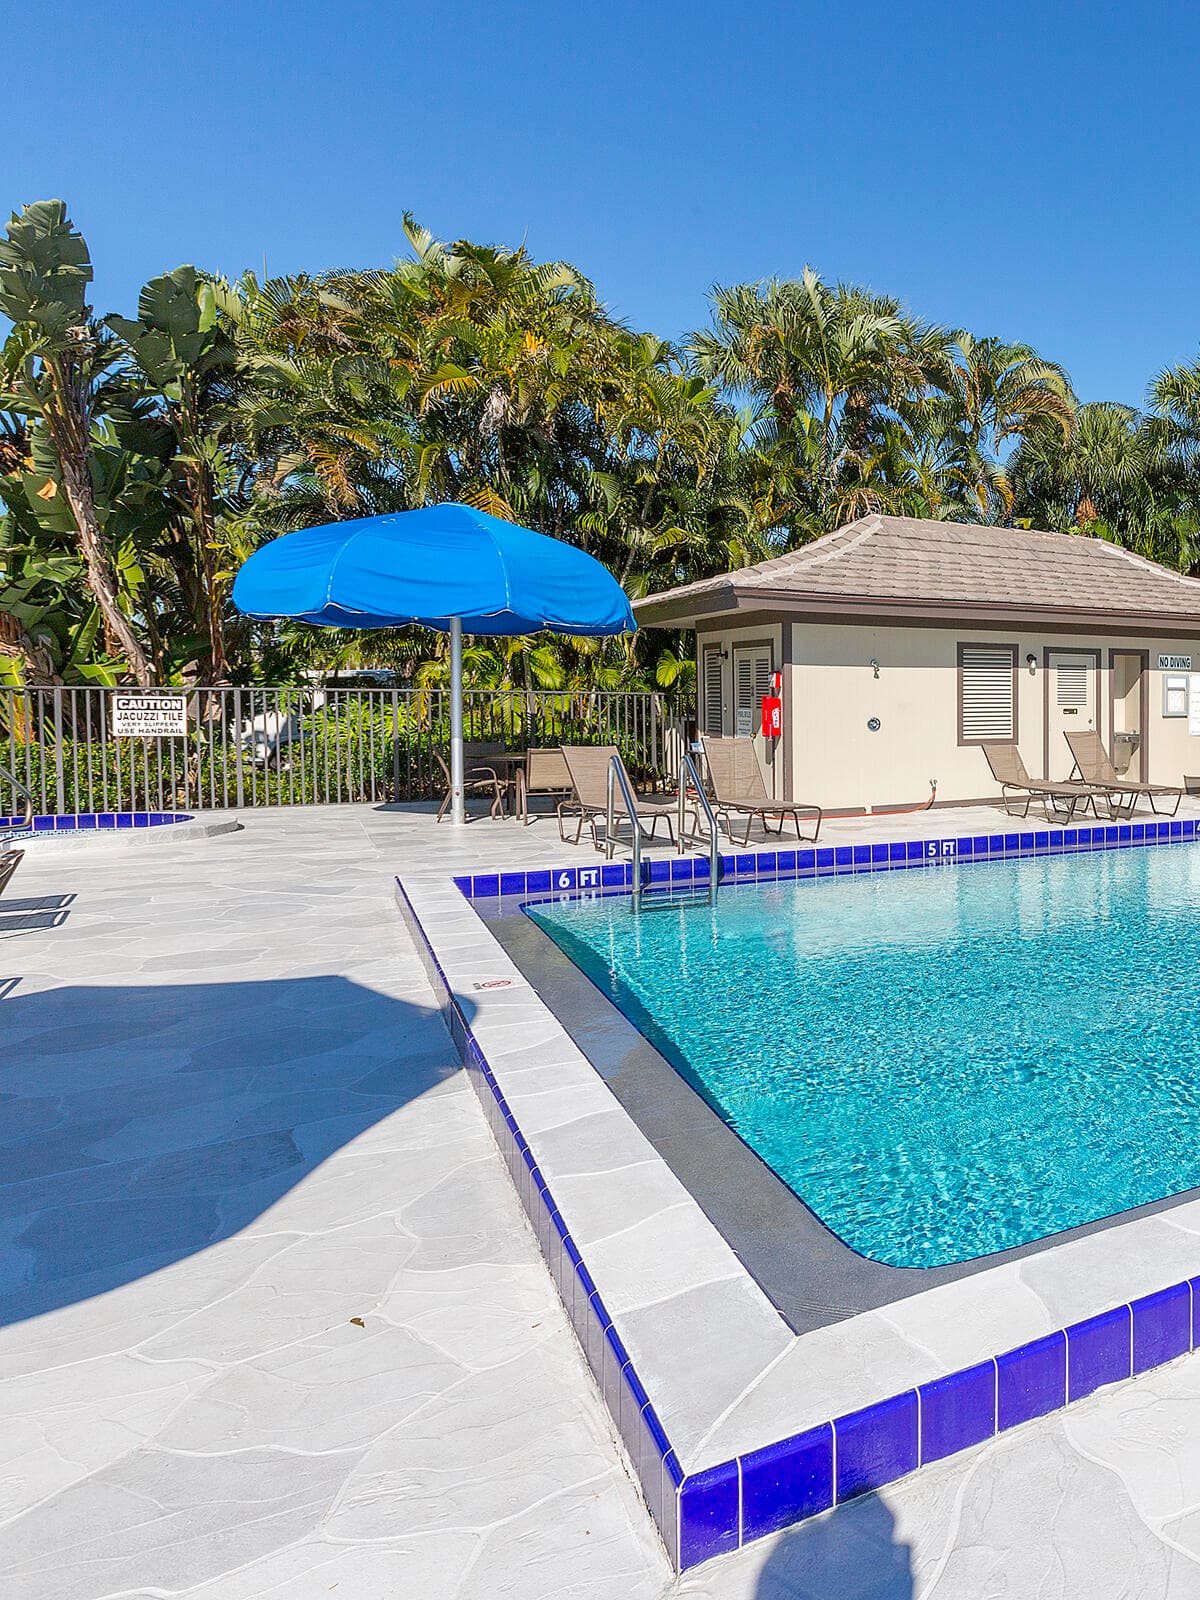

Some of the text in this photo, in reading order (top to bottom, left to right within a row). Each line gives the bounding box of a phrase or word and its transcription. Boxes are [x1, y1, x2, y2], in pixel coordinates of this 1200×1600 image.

[1160, 656, 1190, 668] NO DIVING
[118, 700, 182, 710] CAUTION
[117, 712, 183, 721] JACUZZI TILE
[928, 841, 955, 857] 5 FT
[558, 869, 598, 888] 6 FT
